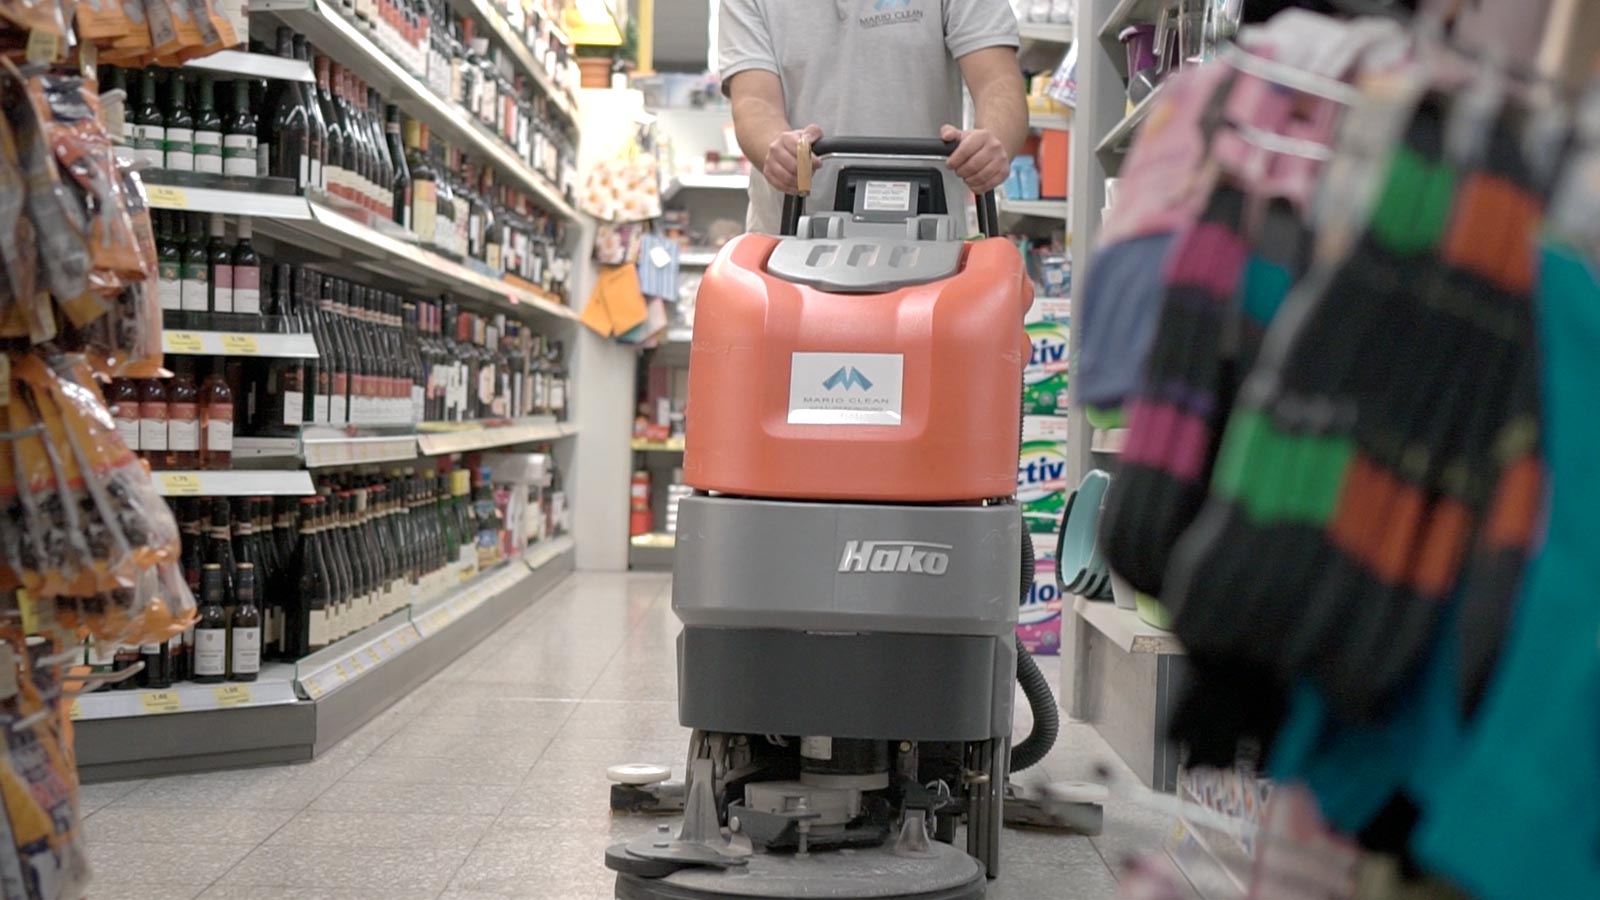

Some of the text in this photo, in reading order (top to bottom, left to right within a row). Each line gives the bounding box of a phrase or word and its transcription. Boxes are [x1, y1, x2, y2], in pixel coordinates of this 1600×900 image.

[859, 13, 891, 27] MARIO
[894, 10, 923, 19] CLEAN
[838, 540, 952, 576] Hako
